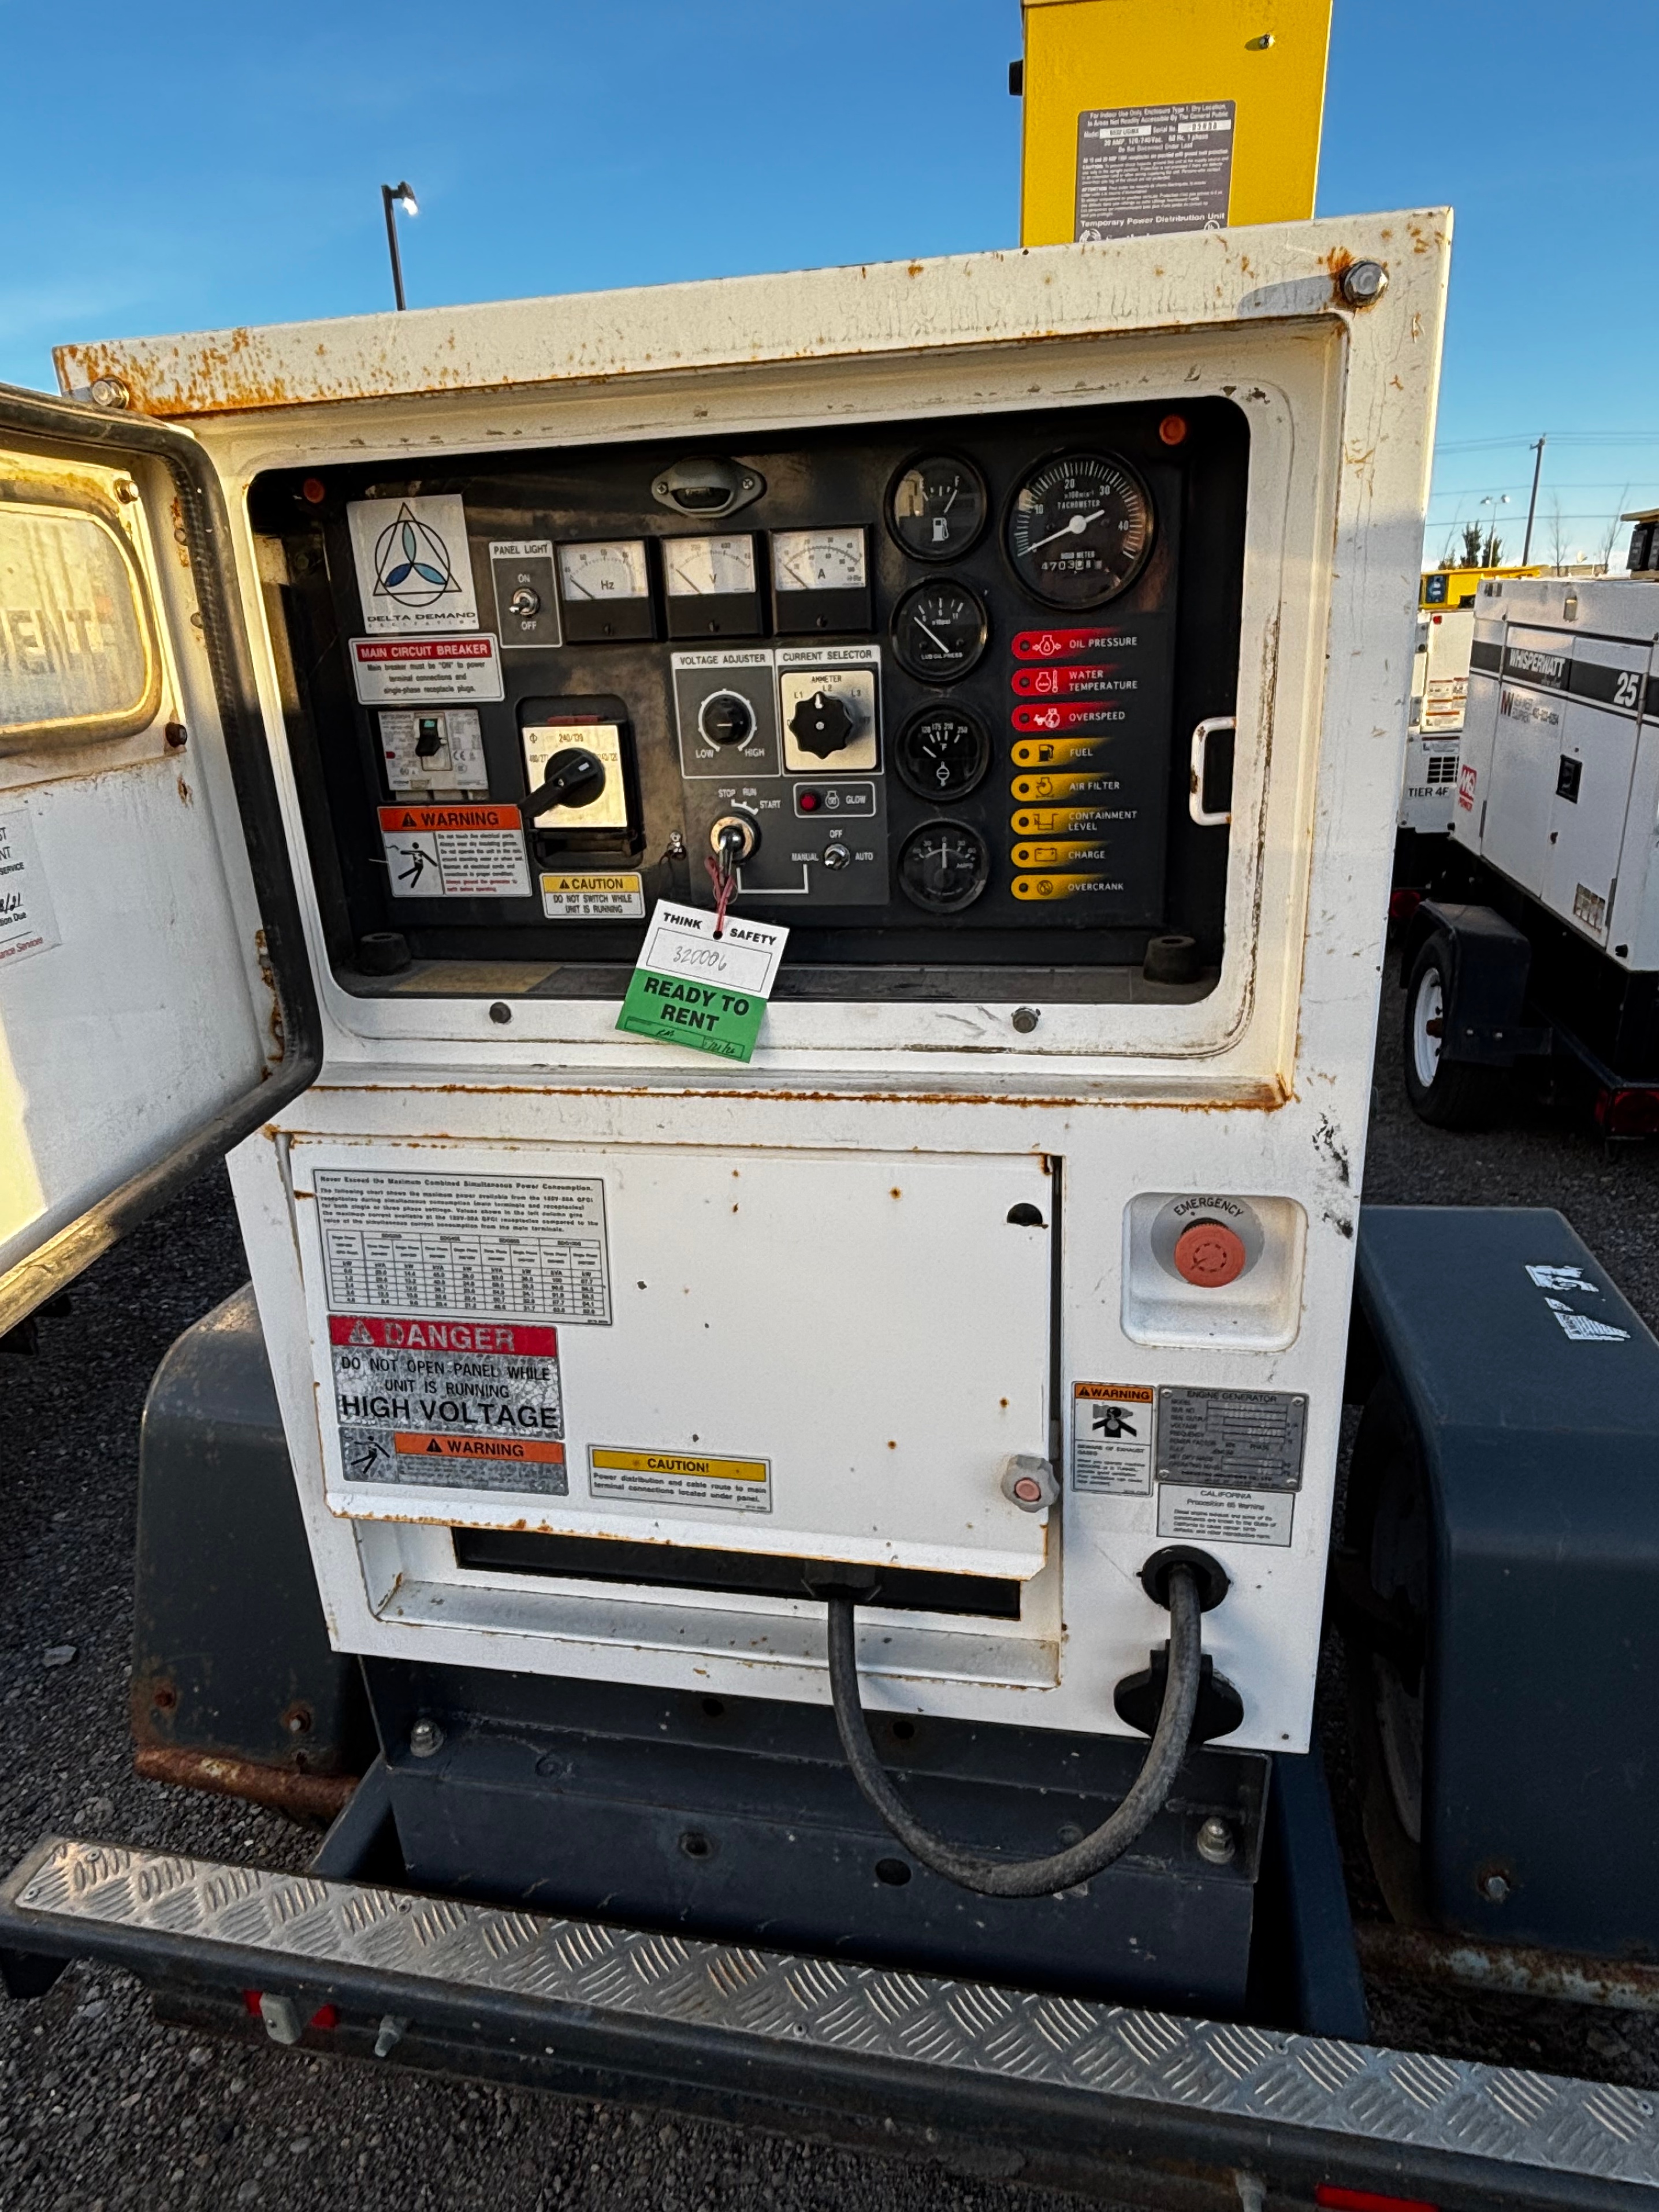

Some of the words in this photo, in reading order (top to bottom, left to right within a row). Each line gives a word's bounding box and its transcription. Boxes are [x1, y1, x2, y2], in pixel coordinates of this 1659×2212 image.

[1156, 215, 1205, 223] Distribution
[1065, 479, 1074, 489] 20
[1100, 486, 1110, 495] 30
[1036, 505, 1043, 514] 10
[1057, 500, 1100, 509] TACHOMETER
[1118, 520, 1129, 530] 40
[494, 545, 520, 555] PANEL
[524, 544, 548, 553] LIGHT
[518, 574, 530, 582] ON
[709, 574, 716, 583] V
[817, 569, 825, 579] A
[600, 580, 613, 589] Hz
[521, 621, 535, 630] OFF
[1069, 639, 1085, 649] OIL
[1088, 637, 1137, 647] PRESSURE
[361, 647, 387, 658] MAIN
[392, 646, 432, 657] CIRCUIT
[437, 644, 488, 655] BREAKER
[782, 651, 821, 661] CURRENT
[827, 650, 871, 660] SELECTOR
[680, 656, 717, 665] VOLTAGE
[723, 654, 765, 663] ADJUSTER
[1509, 649, 1565, 677] WHISPERWATT
[1069, 670, 1103, 679] WATER
[1069, 681, 1138, 691] TEMPERATURE
[1613, 672, 1640, 707] 25
[850, 689, 860, 697] L3
[1069, 712, 1125, 721] OVERSPEED
[695, 749, 713, 758] LOW
[745, 748, 764, 757] HIGH
[1070, 748, 1093, 757] FUEL
[1070, 783, 1084, 791] AIR
[1088, 781, 1120, 790] FILTER
[718, 789, 735, 798] STOP
[742, 788, 756, 796] RUN
[1408, 787, 1433, 797] TIER
[1435, 787, 1449, 796] 4F
[759, 800, 780, 809] START
[845, 795, 866, 804] GLOW
[421, 811, 498, 826] WARNING
[1069, 811, 1137, 820] CONTAINMENT
[829, 829, 842, 838] OFF
[791, 852, 819, 861] MANUAL
[854, 852, 873, 861] AUTO
[1068, 851, 1106, 859] CHARGE
[572, 878, 623, 889] CAUTION
[553, 895, 563, 903] DO
[567, 895, 579, 903] NOT
[611, 894, 632, 902] WHILE
[13, 913, 27, 921] Due
[664, 913, 703, 930] THINK
[730, 928, 776, 945] SAFETY
[16, 938, 43, 953] Services
[674, 947, 727, 971] 320006
[643, 977, 717, 1007] READY
[721, 995, 749, 1015] TO
[660, 1004, 719, 1031] RENT
[1174, 1197, 1244, 1217] EMERGENCY
[384, 1322, 515, 1351] DANGER
[341, 1356, 360, 1370] DO
[370, 1358, 396, 1372] NOT
[408, 1360, 444, 1375] OPEN
[454, 1362, 499, 1378] PANEL
[508, 1366, 550, 1381] WHILE
[385, 1379, 415, 1392] UNIT
[425, 1381, 436, 1393] IS
[446, 1381, 509, 1398] RUNNING
[1092, 1387, 1150, 1400] WARNING
[1187, 1391, 1219, 1400] ENGINE
[1222, 1392, 1277, 1403] GENERATOR
[342, 1395, 410, 1419] HIGH
[419, 1399, 559, 1428] VOLTAGE
[448, 1440, 524, 1457] WARNING
[648, 1458, 709, 1473] CAUTION!
[594, 1472, 616, 1481] Power
[622, 1474, 664, 1485] distribution
[686, 1480, 706, 1488] cable
[594, 1482, 624, 1490] terminal
[628, 1484, 674, 1494] connections
[678, 1488, 706, 1498] located
[710, 1491, 732, 1499] under
[737, 1494, 760, 1502] panel.
[1200, 1491, 1251, 1499] CALIFORNIA
[1187, 1499, 1224, 1507] Proposition
